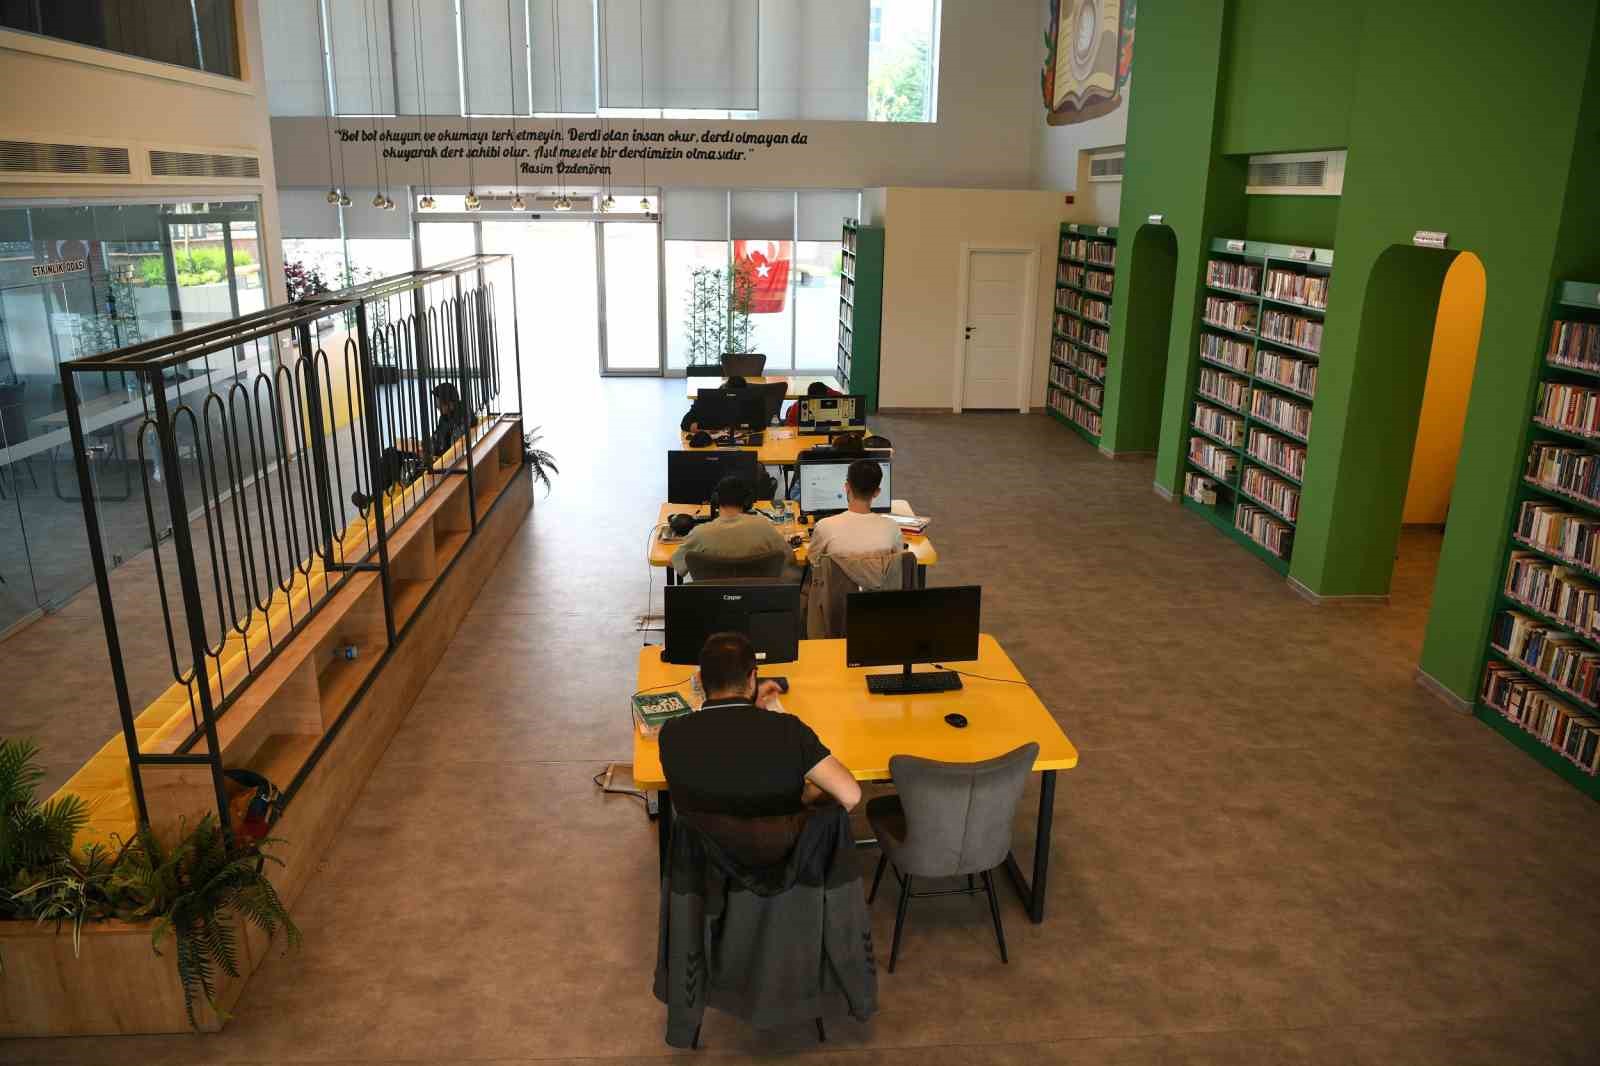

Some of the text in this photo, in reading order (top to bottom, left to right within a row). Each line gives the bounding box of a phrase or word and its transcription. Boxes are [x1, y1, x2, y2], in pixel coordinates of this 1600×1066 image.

[361, 129, 378, 141] bol
[379, 130, 421, 145] okuyun
[423, 132, 436, 141] ve
[438, 130, 488, 145] okumayı
[492, 129, 514, 141] terk
[567, 128, 601, 141] Derdi
[603, 130, 629, 141] olan
[632, 129, 665, 142] insan
[701, 130, 735, 143] derdi
[735, 132, 789, 148] olmayan
[790, 132, 808, 145] da
[382, 146, 438, 162] okuyarak
[440, 146, 464, 158] dert
[466, 146, 500, 158] sahibi
[560, 148, 599, 158] mesele
[600, 147, 617, 159] bir
[618, 147, 683, 159] derdimizin
[520, 160, 612, 175] Rasim Özdenören
